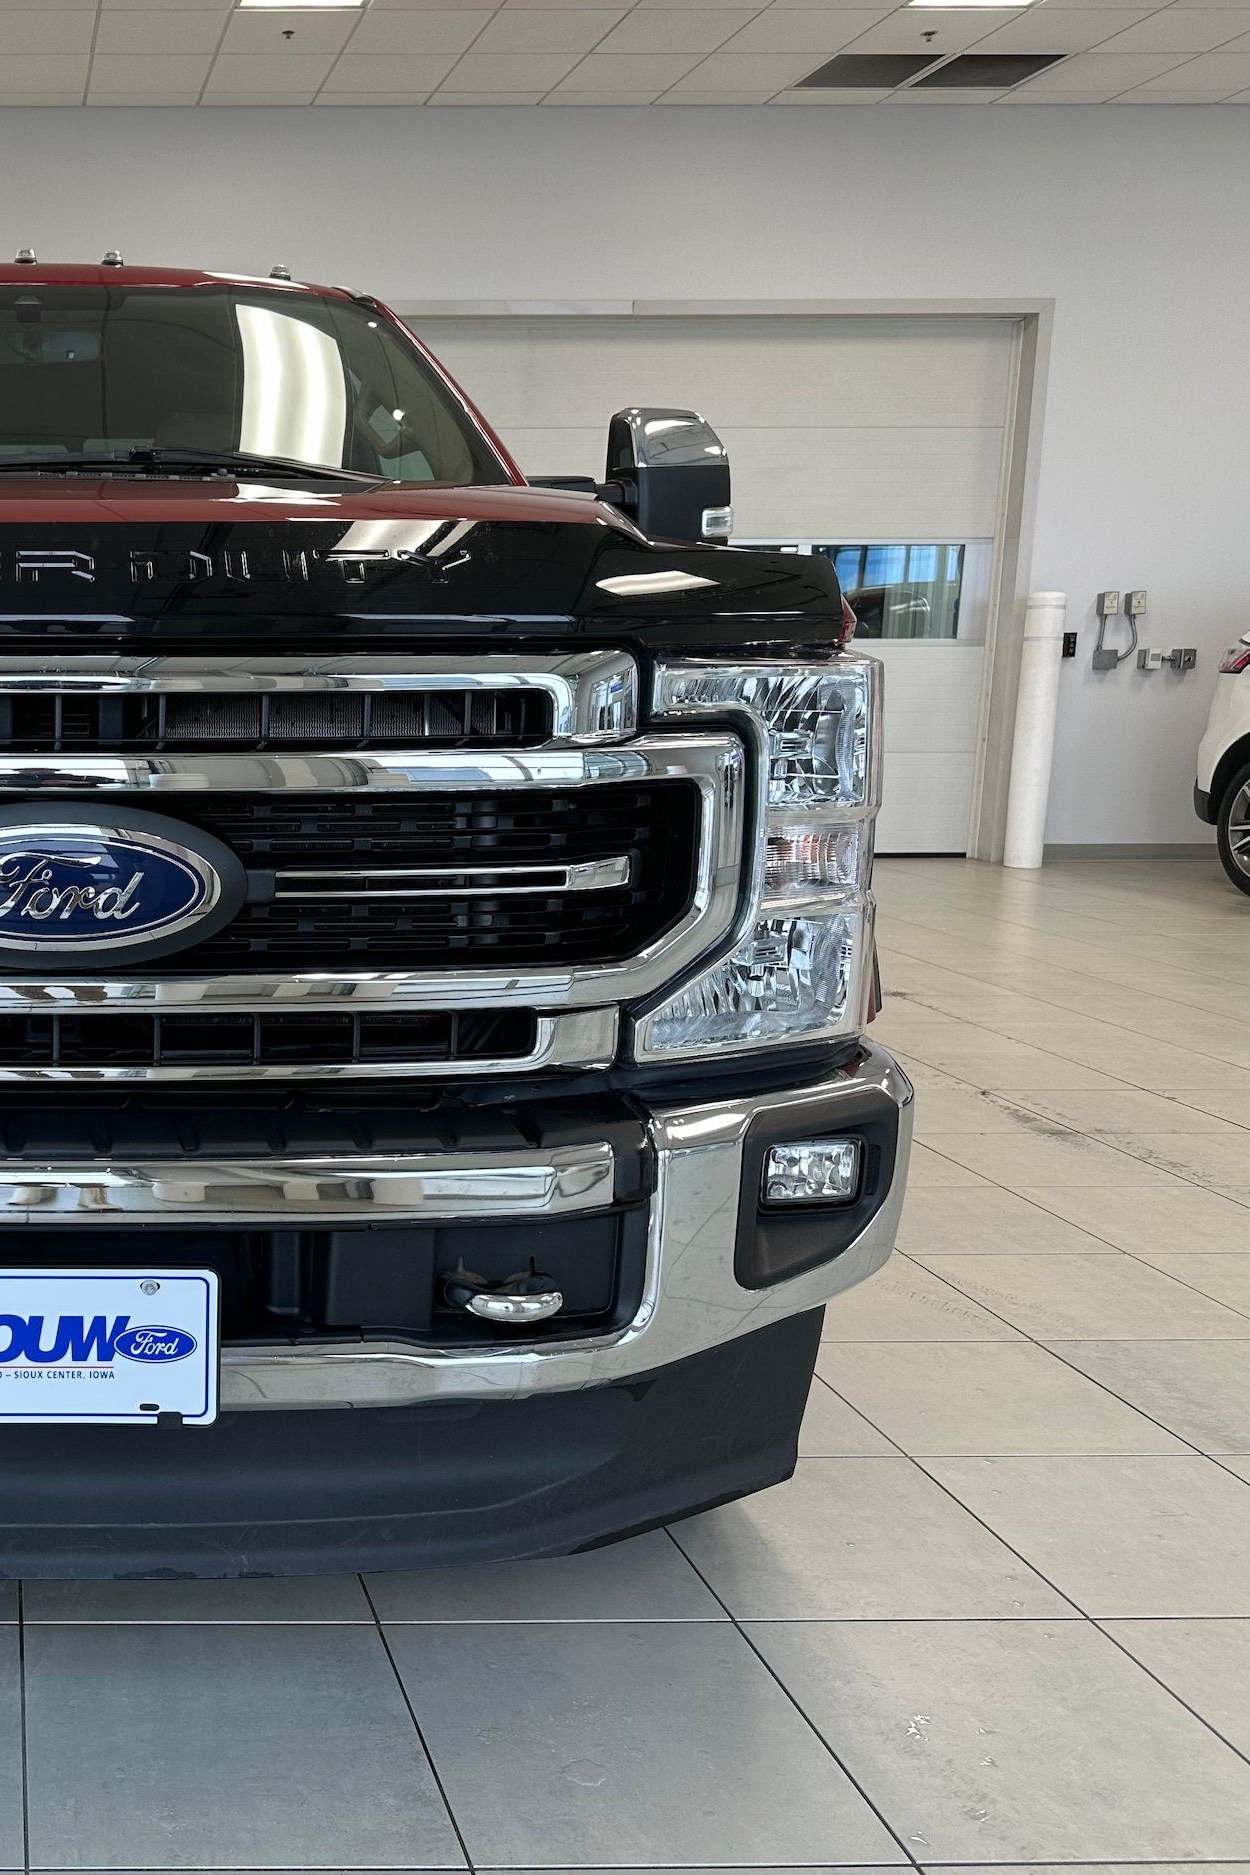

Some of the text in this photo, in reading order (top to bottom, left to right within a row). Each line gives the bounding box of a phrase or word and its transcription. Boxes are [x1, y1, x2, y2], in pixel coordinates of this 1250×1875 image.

[130, 549, 471, 583] DUTY
[129, 1330, 179, 1356] Ford
[14, 1370, 43, 1379] SIOUX
[47, 1370, 86, 1380] CENTER,
[89, 1370, 115, 1379] IOWA
